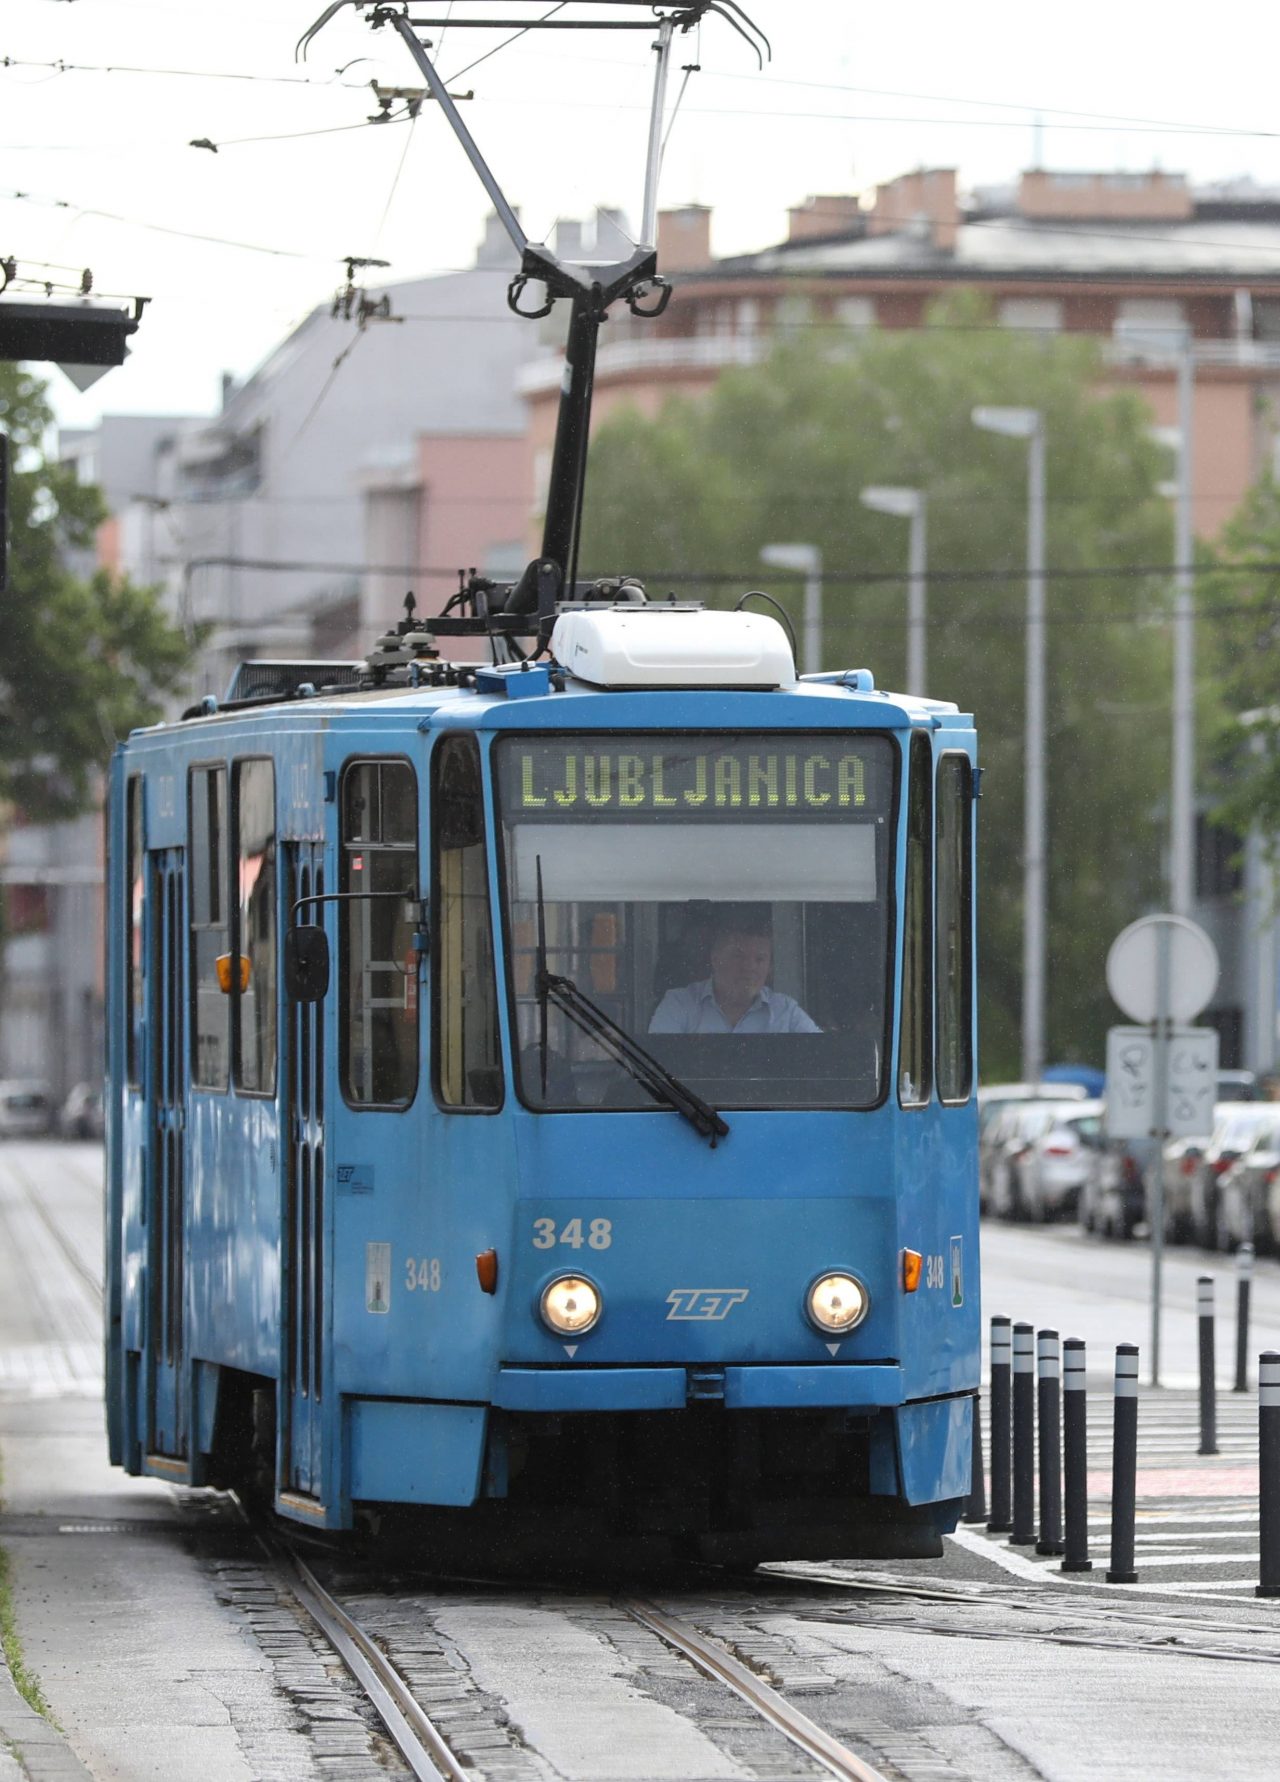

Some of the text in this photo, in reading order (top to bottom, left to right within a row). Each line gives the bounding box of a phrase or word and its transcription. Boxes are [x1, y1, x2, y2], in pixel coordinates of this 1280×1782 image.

[522, 756, 866, 806] LJUBLJANICA
[533, 1218, 612, 1250] 348
[405, 1258, 440, 1292] 348
[927, 1255, 943, 1288] 348
[665, 1289, 749, 1321] ZET
